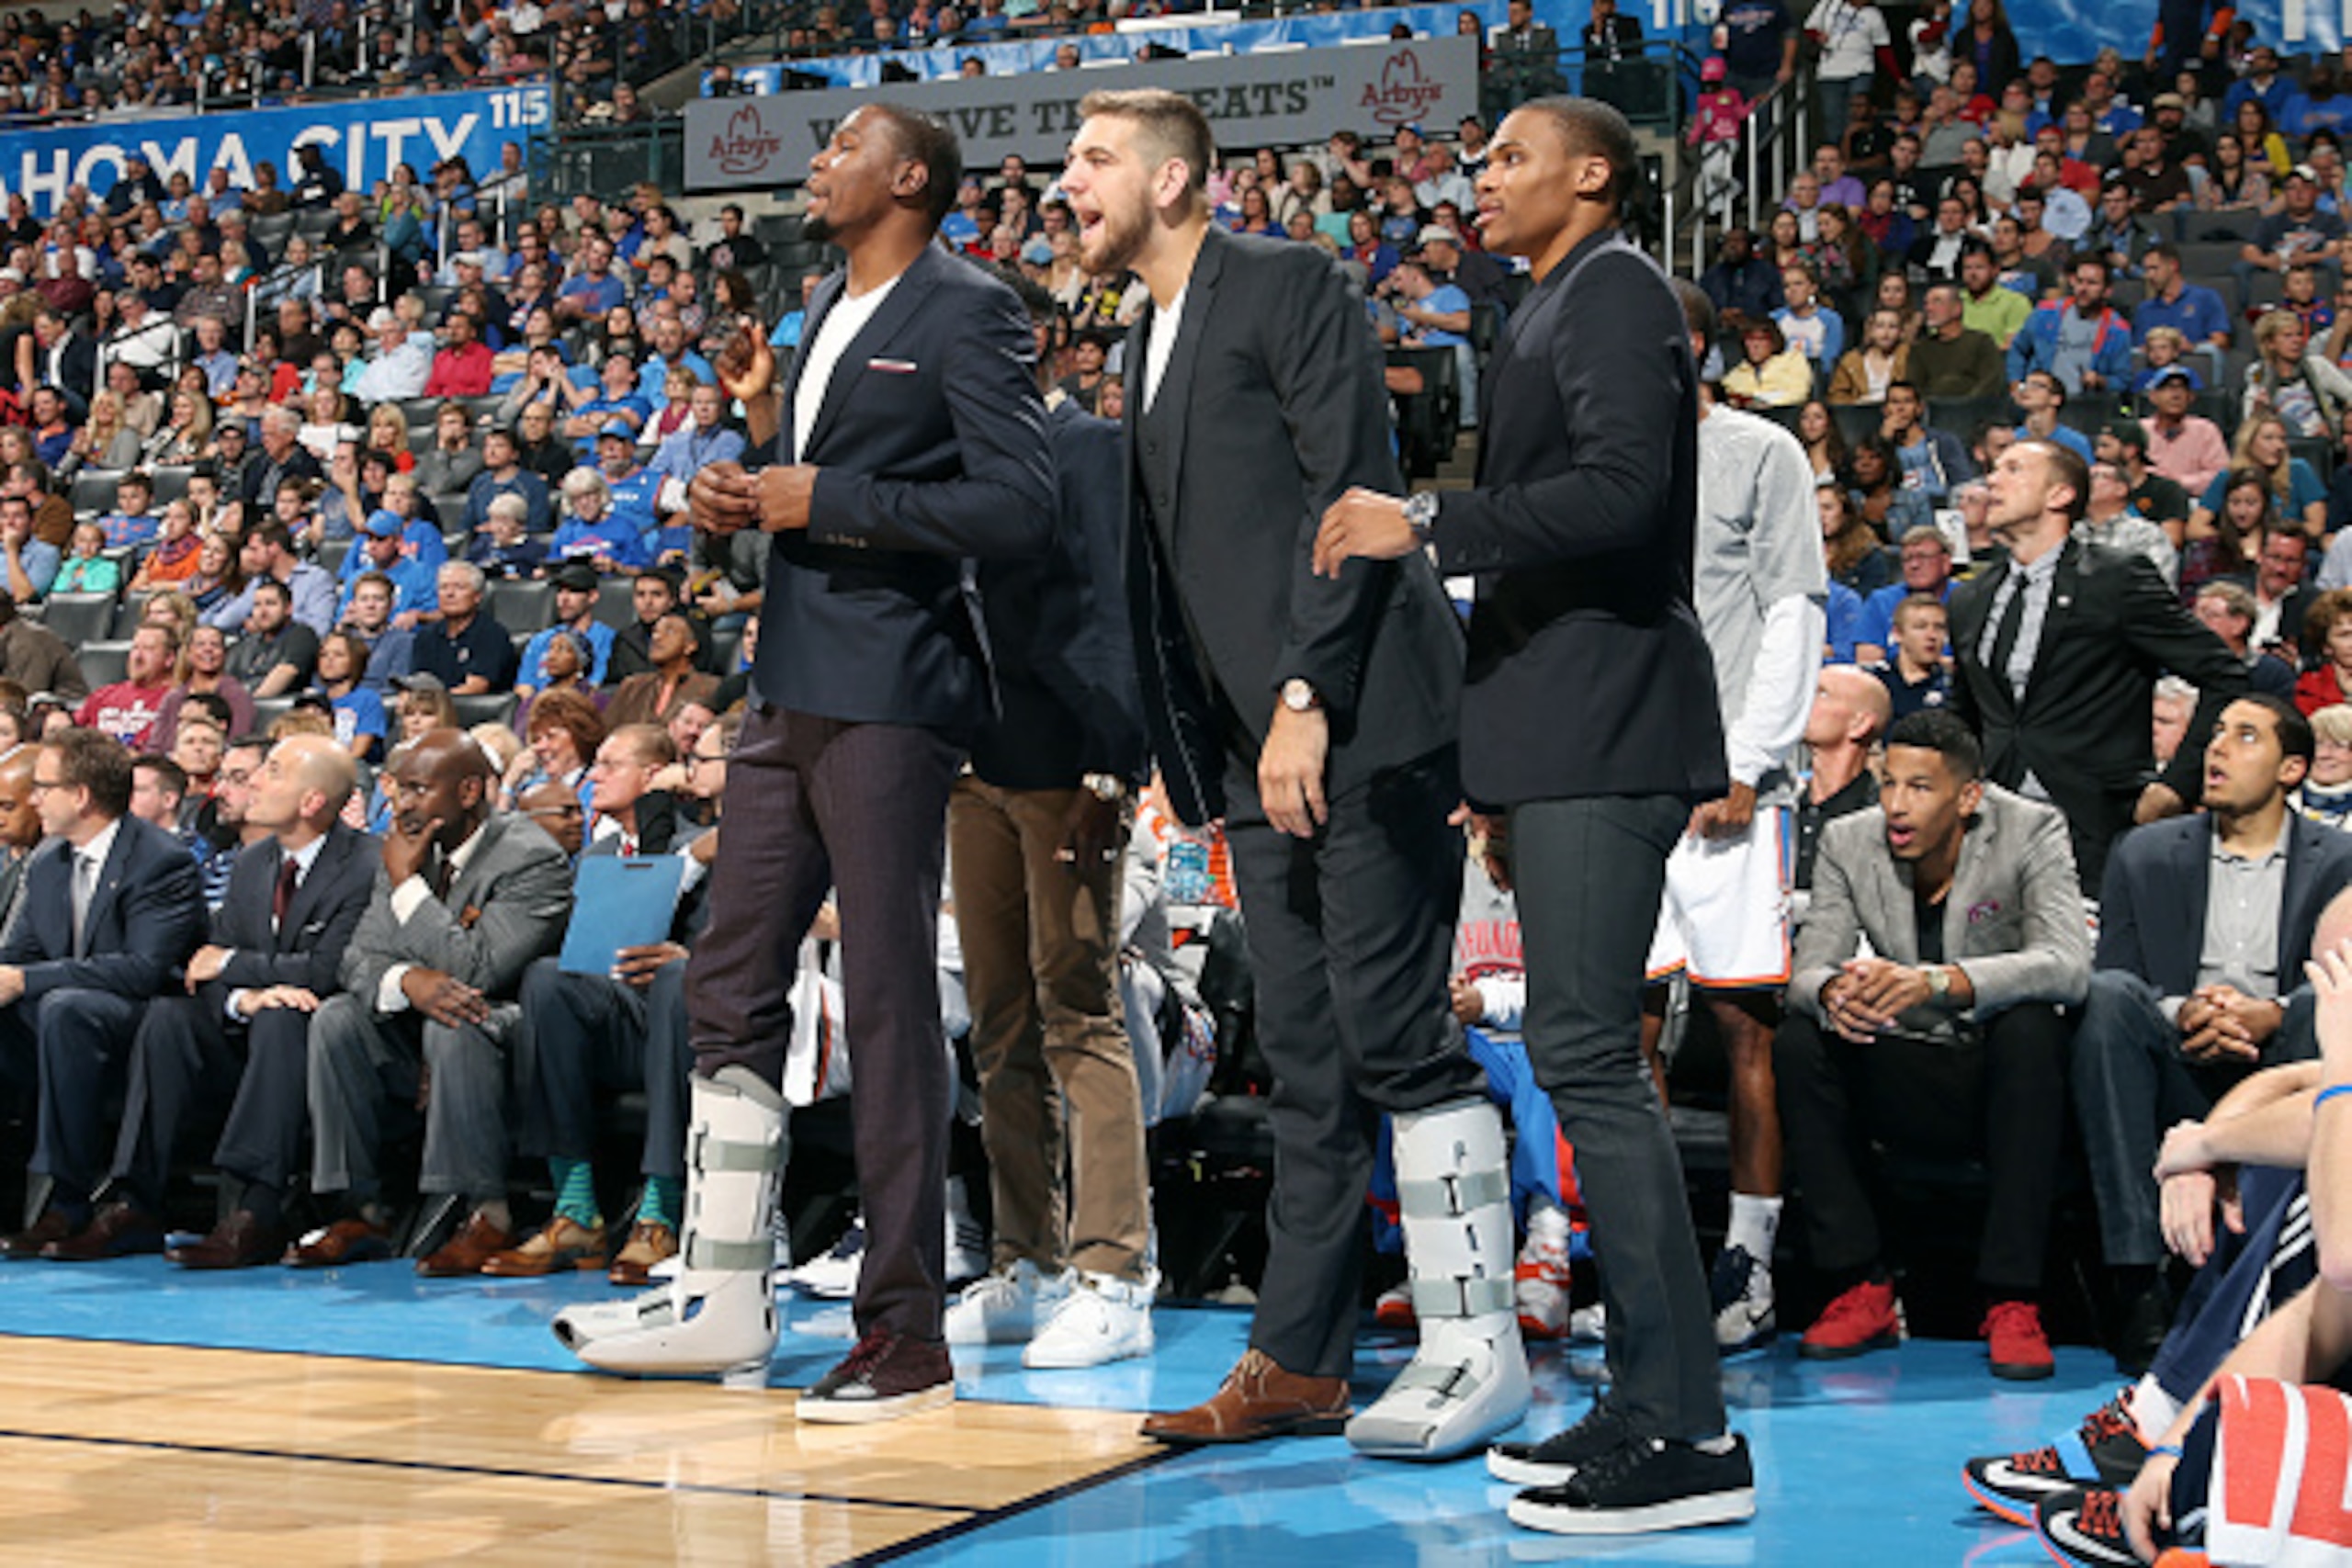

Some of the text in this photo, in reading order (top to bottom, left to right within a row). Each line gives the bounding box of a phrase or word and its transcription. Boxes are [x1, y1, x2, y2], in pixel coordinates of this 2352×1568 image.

[489, 89, 549, 129] 115
[1360, 76, 1445, 109] Arby's
[708, 130, 781, 163] Arby's
[0, 132, 259, 220] HOMA
